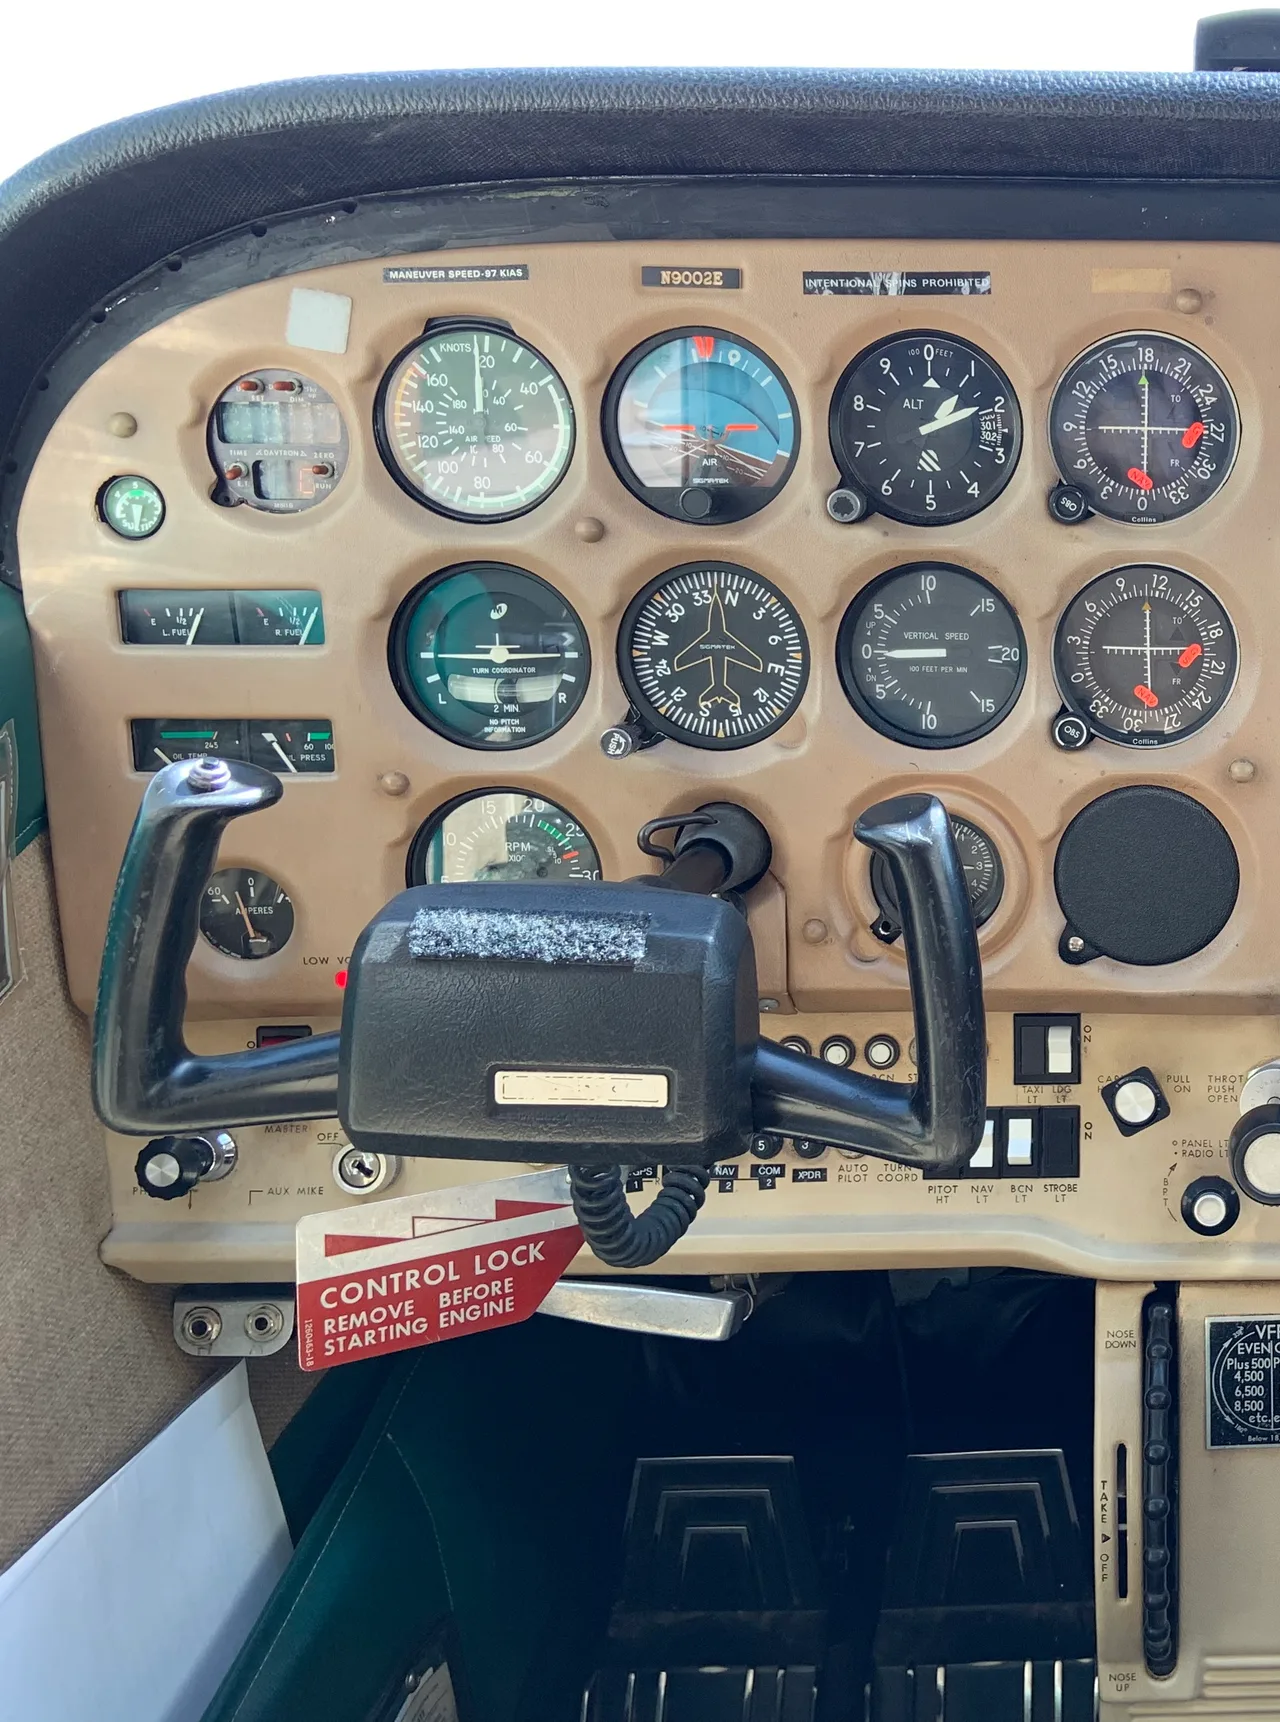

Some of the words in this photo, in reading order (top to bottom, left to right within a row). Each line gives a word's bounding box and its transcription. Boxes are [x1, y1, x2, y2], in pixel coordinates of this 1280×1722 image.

[389, 269, 446, 280] MANEUVER
[500, 267, 523, 277] KIAS
[660, 270, 723, 286] N9002E
[805, 278, 881, 288] INTENTIONAL
[885, 278, 917, 288] SPINS
[922, 278, 989, 287] PROHIBITED
[439, 342, 472, 353] KNOTS
[924, 344, 934, 360] 0
[1138, 347, 1154, 362] 18
[880, 358, 891, 373] 9
[427, 374, 448, 386] 160
[413, 400, 434, 413] 140
[853, 396, 864, 411] 8
[903, 399, 924, 410] ALT
[418, 435, 438, 448] 120
[474, 477, 491, 489] 80
[882, 479, 893, 495] 6
[926, 494, 936, 510] 5
[921, 575, 936, 591] 10
[1152, 574, 1169, 590] 12
[692, 590, 712, 606] 33
[725, 590, 739, 607] N
[980, 598, 995, 612] 15
[903, 632, 939, 640] VERTICAL
[1001, 647, 1019, 661] 20
[438, 693, 447, 704] L
[558, 692, 567, 703] R
[493, 704, 499, 713] 2
[922, 714, 937, 730] 10
[1064, 725, 1080, 738] OBS
[300, 754, 326, 762] PRESS
[505, 842, 531, 852] RPM
[303, 957, 329, 965] LOW
[1166, 1075, 1191, 1083] PULL
[1052, 1085, 1072, 1093] LDG
[1173, 1085, 1191, 1093] ON
[1207, 1085, 1235, 1093] PUSH
[1208, 1094, 1238, 1103] OPEN
[264, 1125, 308, 1134] MASTER
[1181, 1140, 1213, 1148] PANEL
[1181, 1149, 1214, 1158] RADIO
[758, 1166, 781, 1176] COM
[798, 1170, 822, 1180] XPDR
[838, 1173, 868, 1183] PILOT
[877, 1173, 918, 1183] COORD
[267, 1187, 290, 1196] AUX
[297, 1187, 324, 1196] MIKE
[928, 1185, 958, 1194] PITOT
[971, 1185, 994, 1193] NAV
[1011, 1184, 1033, 1193] BCN
[1044, 1184, 1078, 1192] STROBE
[320, 1260, 460, 1309] CONTROL
[474, 1240, 546, 1276] LOCK
[324, 1300, 415, 1335] REMOVE
[439, 1277, 514, 1309] BEFORE
[324, 1317, 429, 1357] STARTING
[439, 1296, 515, 1329] ENGINE
[1107, 1330, 1134, 1338] NOSE
[304, 1319, 314, 1367] 1260463-18
[1105, 1340, 1137, 1349] DOWN
[1237, 1342, 1271, 1354] EVEN
[1227, 1358, 1249, 1370] Plus
[1251, 1358, 1271, 1369] 500
[1234, 1370, 1264, 1383] 4,500
[1234, 1386, 1264, 1398] 6,500
[1234, 1400, 1264, 1413] 8,500
[1248, 1413, 1271, 1423] etc.
[1100, 1480, 1108, 1524] TAKE
[1100, 1553, 1109, 1582] OFF
[1109, 1673, 1136, 1682] NOSE
[1116, 1684, 1130, 1692] UP
